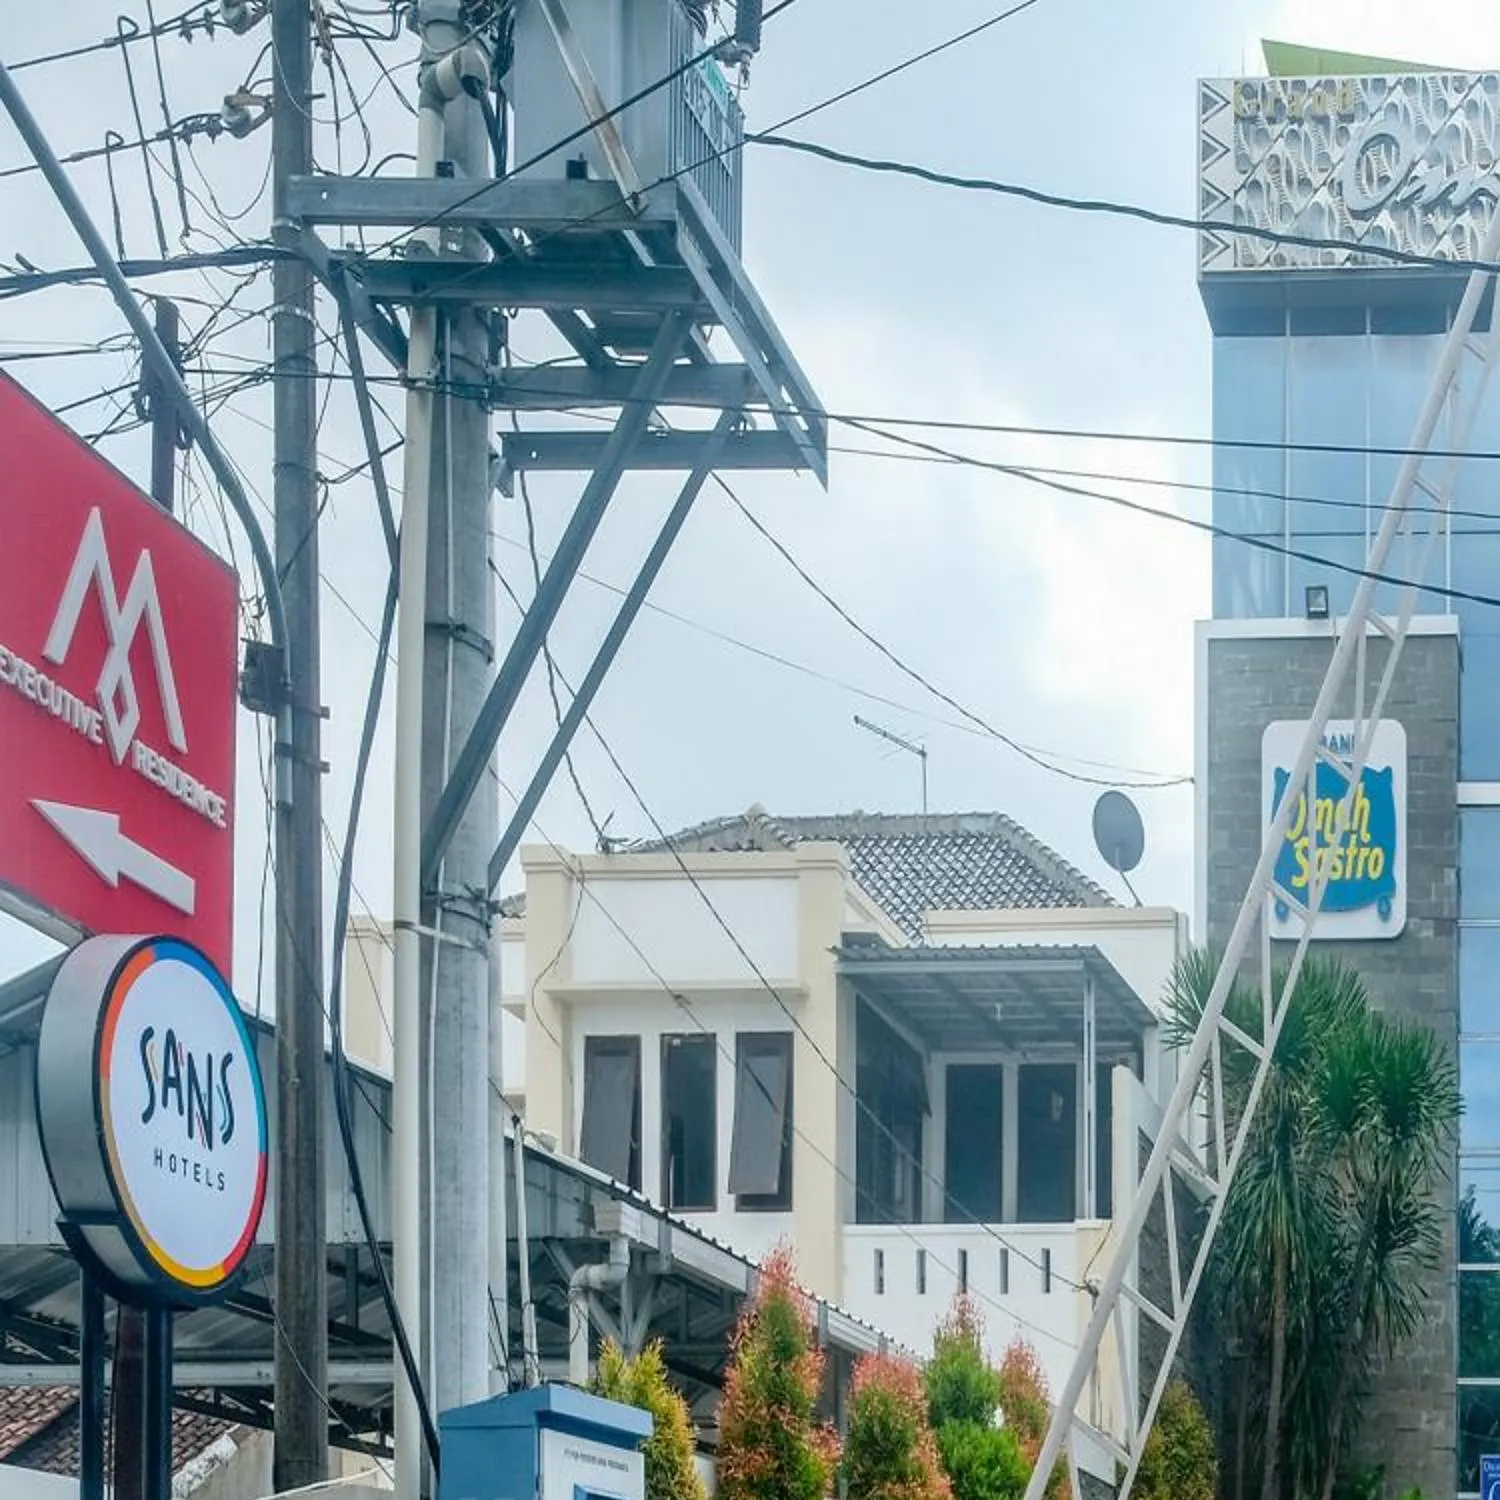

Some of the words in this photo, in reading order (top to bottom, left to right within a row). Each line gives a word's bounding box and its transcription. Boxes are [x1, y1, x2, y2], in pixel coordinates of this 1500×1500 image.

[131, 739, 227, 829] RESIDENCE
[139, 1024, 235, 1151] SANS
[153, 1147, 226, 1192] HOTELS
